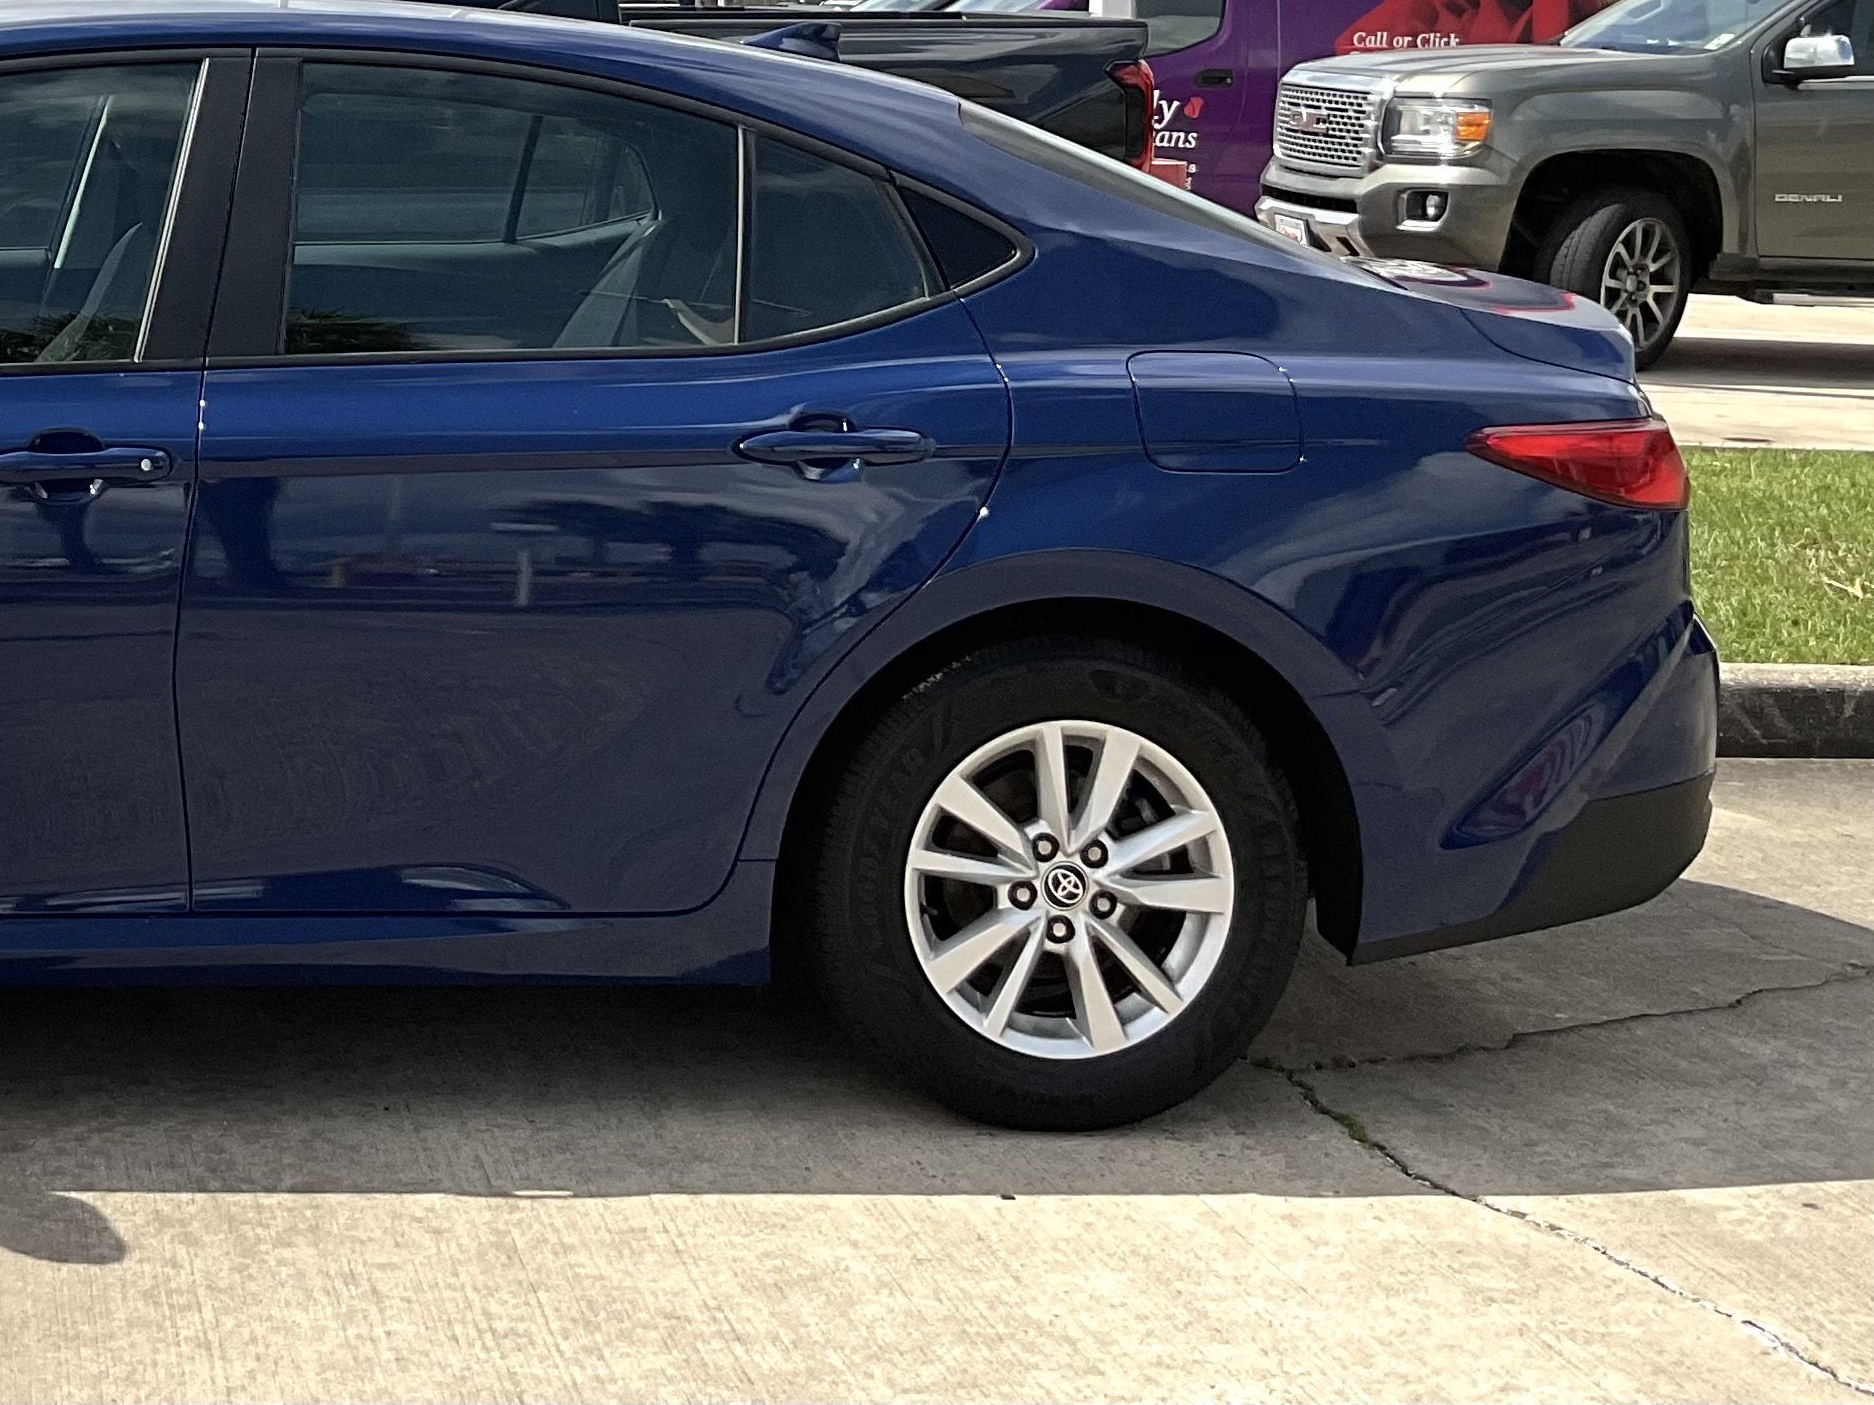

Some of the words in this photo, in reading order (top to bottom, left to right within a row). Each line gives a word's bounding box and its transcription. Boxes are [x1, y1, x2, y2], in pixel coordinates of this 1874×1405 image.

[1352, 31, 1389, 49] Call
[1392, 36, 1413, 49] or
[1416, 32, 1461, 49] Click
